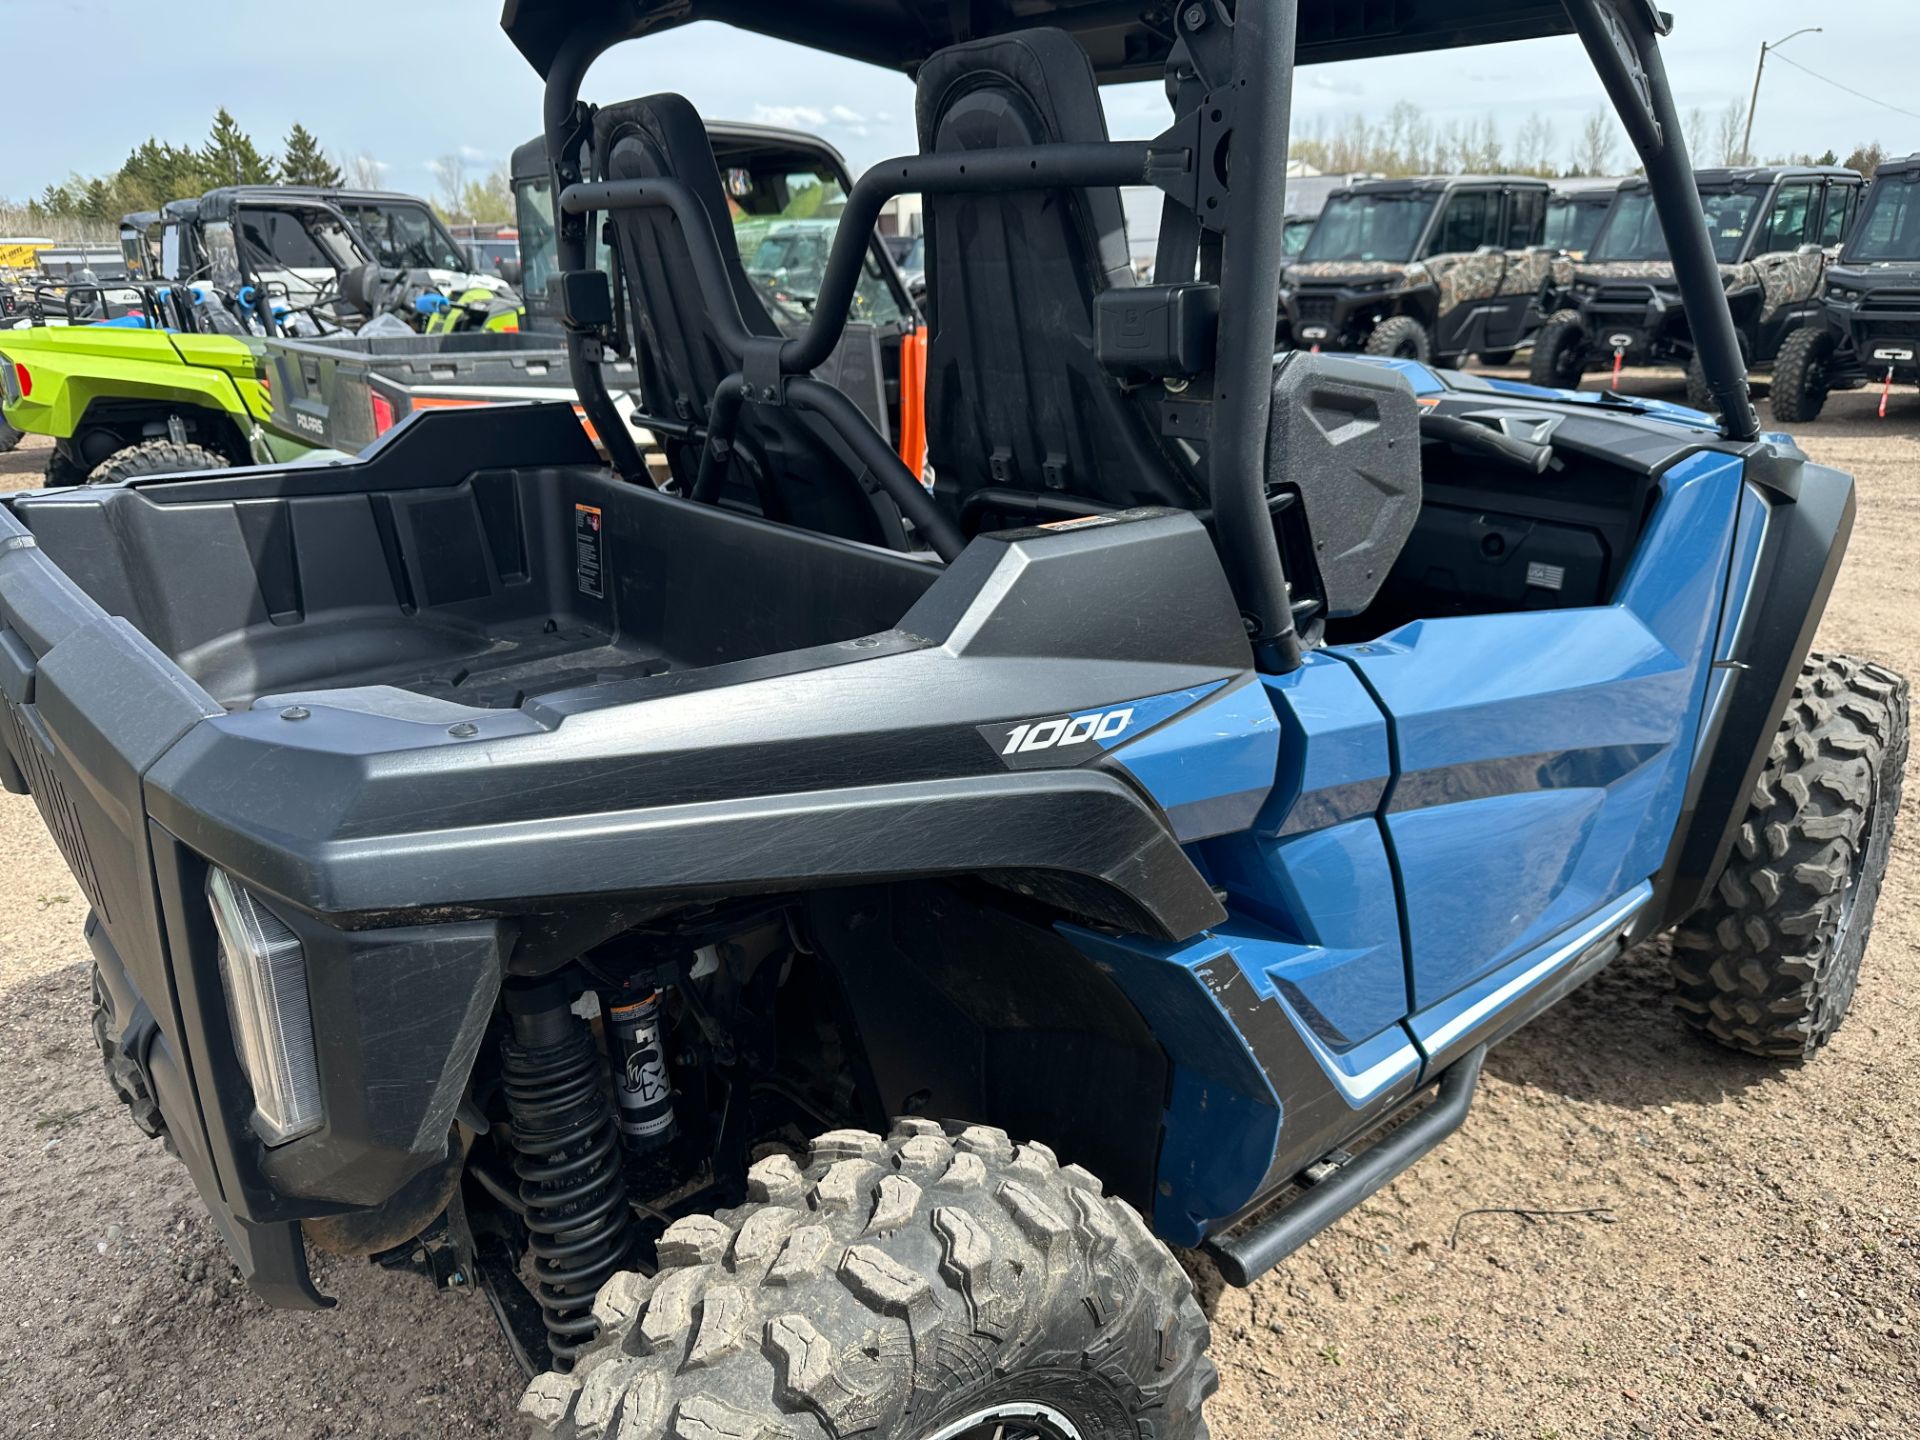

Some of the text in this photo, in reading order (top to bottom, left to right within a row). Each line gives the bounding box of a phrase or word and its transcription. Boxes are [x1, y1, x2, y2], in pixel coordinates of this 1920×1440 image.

[296, 412, 324, 435] POLARIS
[1002, 708, 1134, 755] 1000
[624, 1023, 671, 1102] FOX
